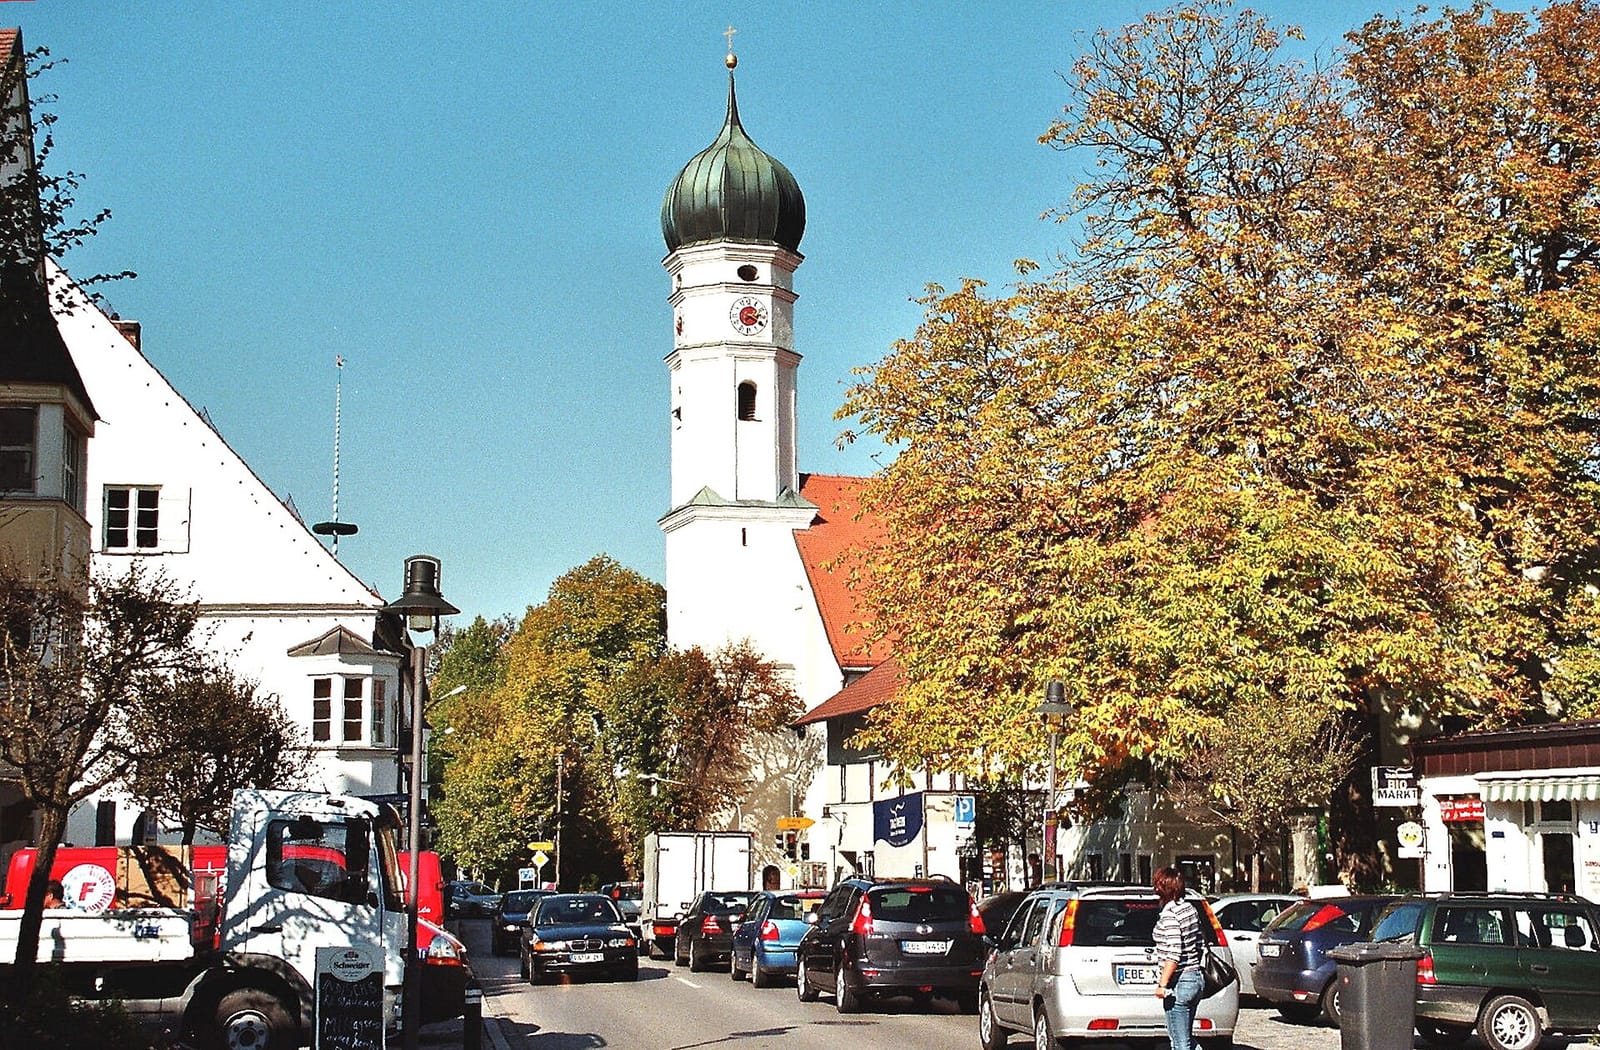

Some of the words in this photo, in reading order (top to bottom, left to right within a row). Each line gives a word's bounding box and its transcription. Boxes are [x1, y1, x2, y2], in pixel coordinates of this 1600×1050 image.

[1388, 780, 1407, 789] BIO
[1378, 790, 1416, 799] MARKT
[959, 798, 970, 820] P
[79, 882, 97, 901] F
[333, 961, 370, 970] Schweiger
[1124, 969, 1145, 980] EBE
